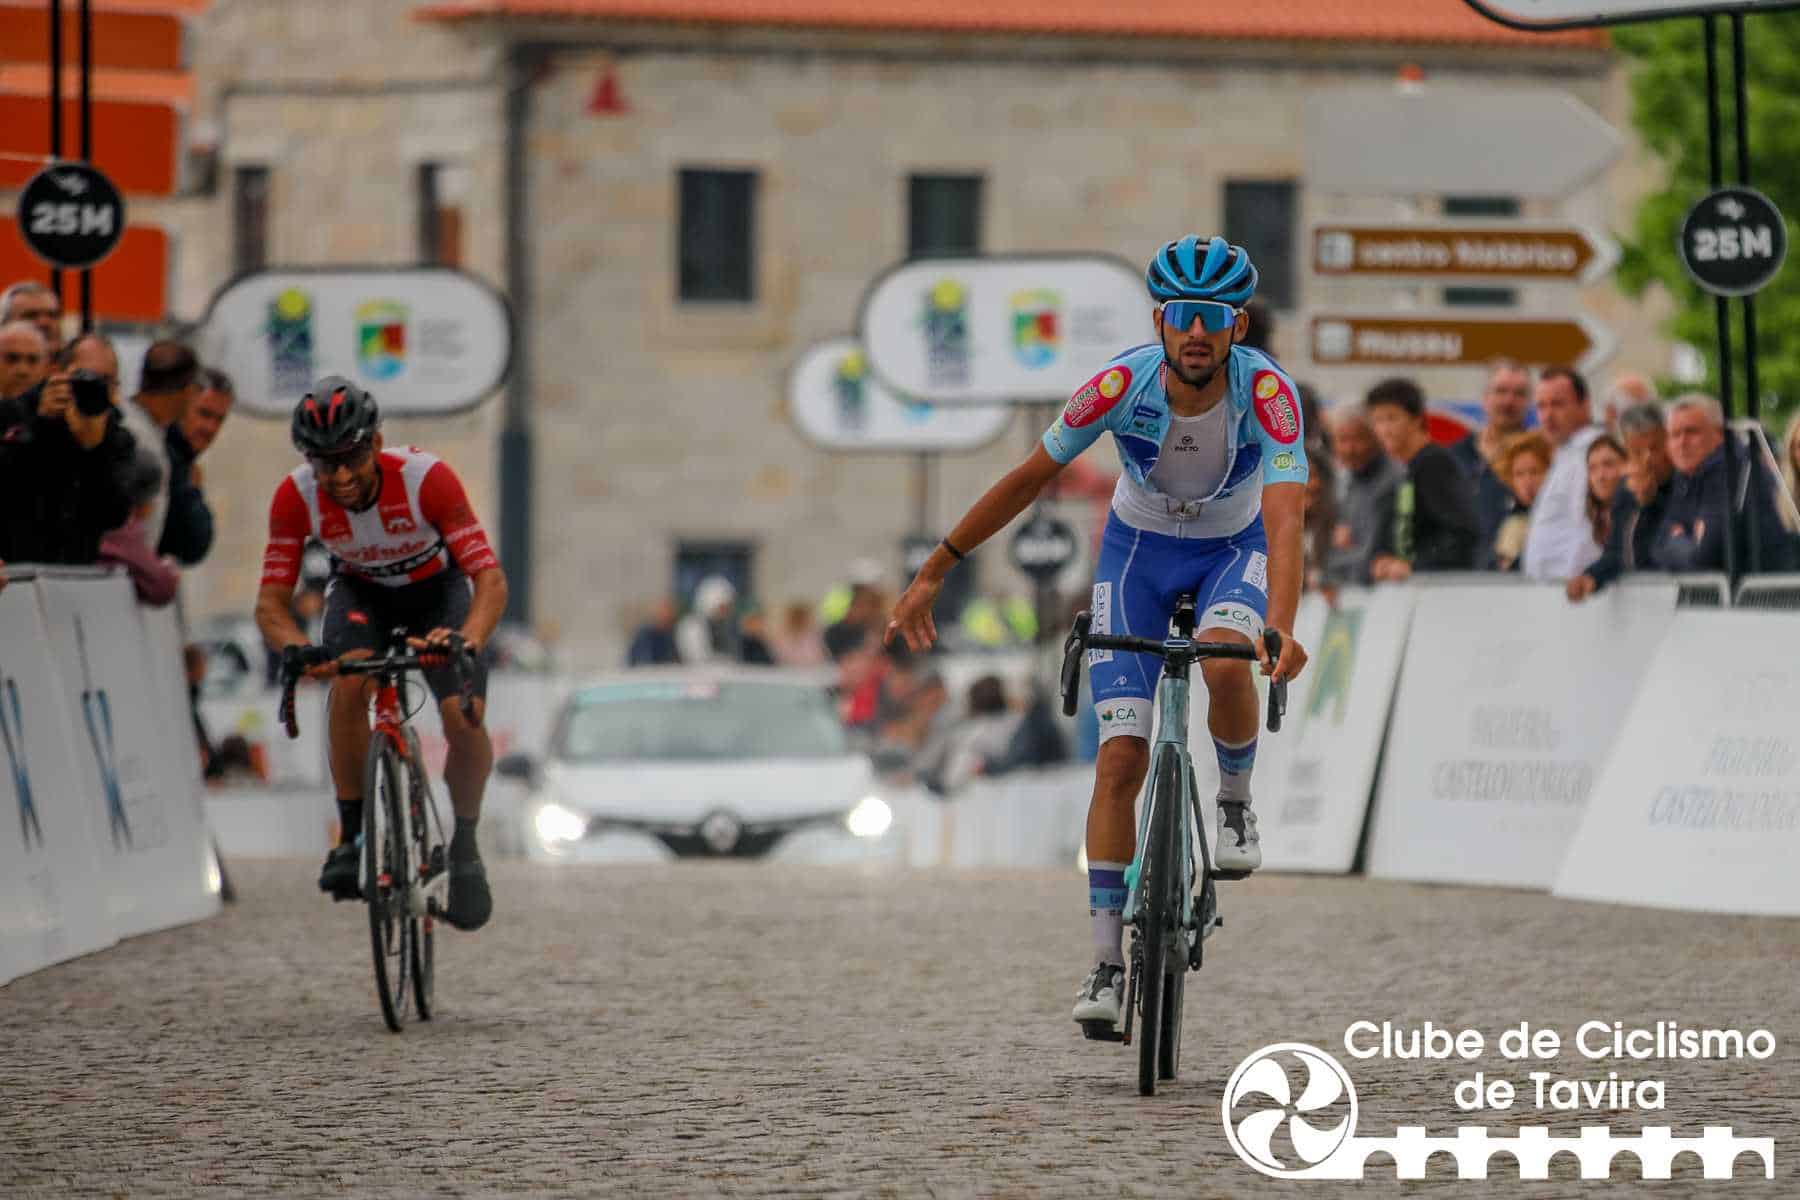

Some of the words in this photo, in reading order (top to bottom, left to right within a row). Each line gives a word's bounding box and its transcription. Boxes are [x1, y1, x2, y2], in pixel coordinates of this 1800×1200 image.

[32, 202, 113, 235] 25M
[1359, 239, 1449, 269] centro
[1694, 225, 1772, 261] 25M
[1357, 331, 1462, 358] museu
[1231, 610, 1252, 627] CA
[1115, 707, 1137, 721] CA
